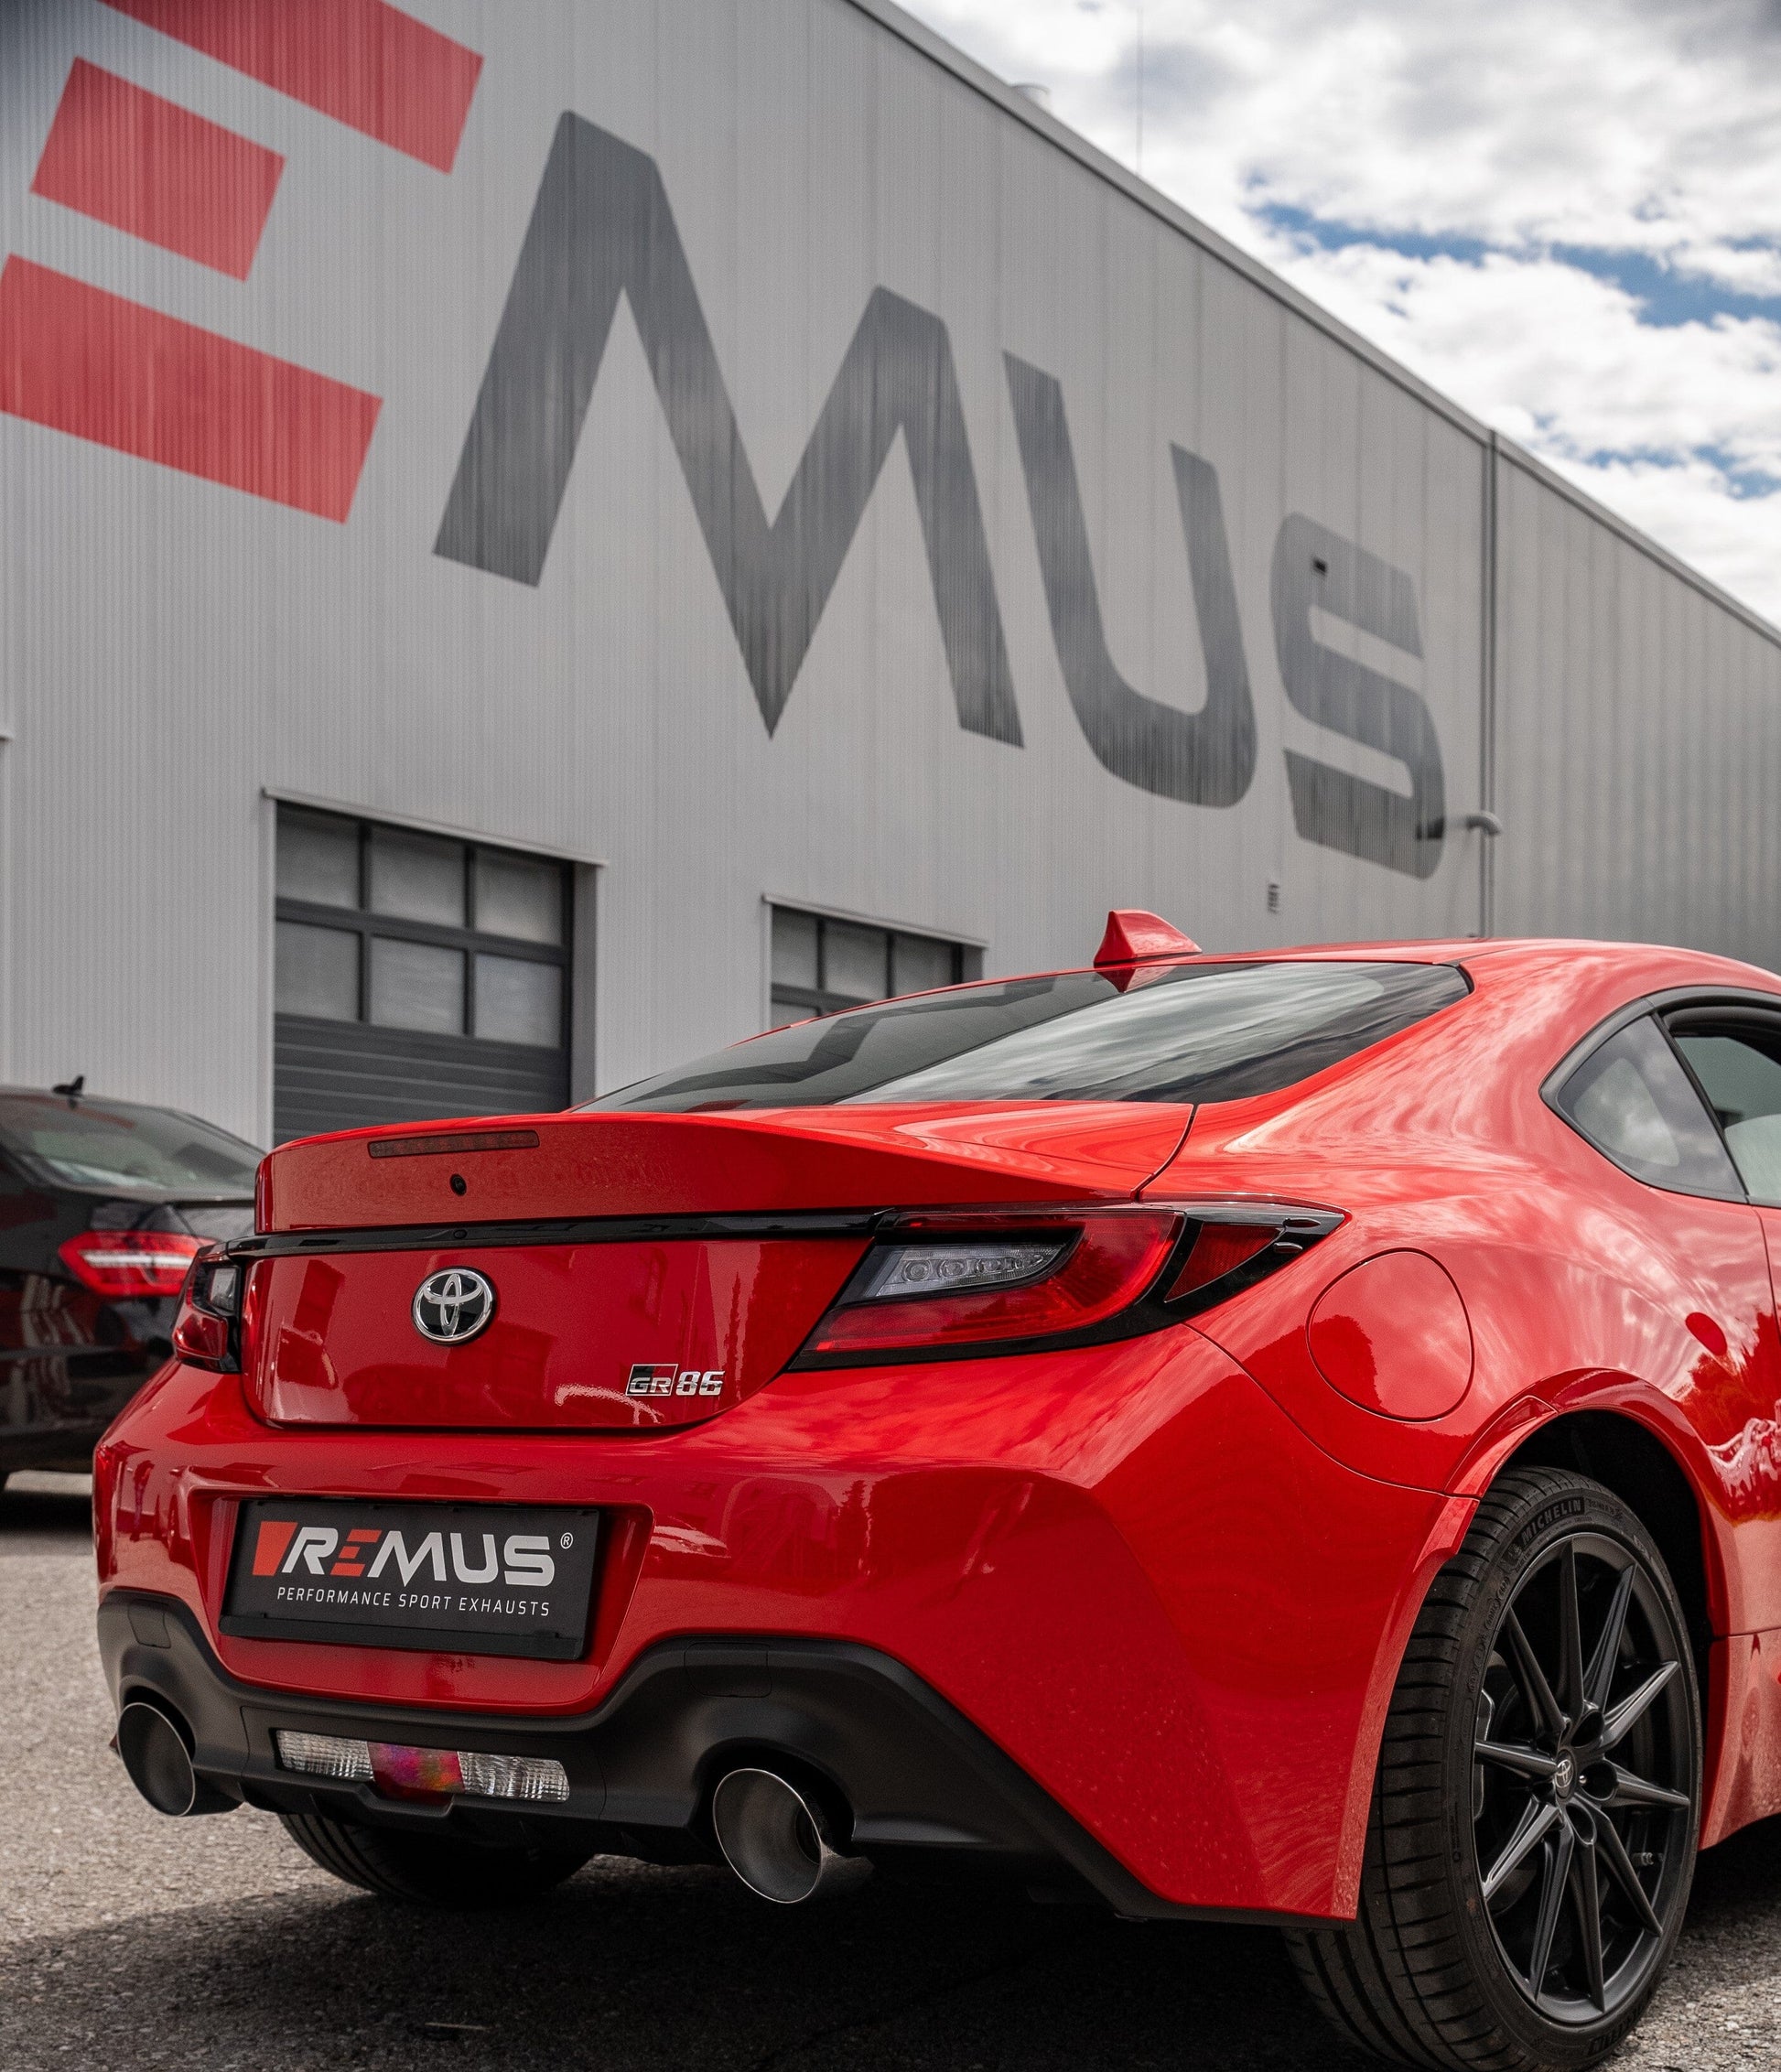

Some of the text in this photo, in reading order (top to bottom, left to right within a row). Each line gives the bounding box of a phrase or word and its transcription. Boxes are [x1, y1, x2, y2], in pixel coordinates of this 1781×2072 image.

[1521, 1499, 1581, 1546] MICHELIN
[277, 1587, 550, 1617] PERFORMANCE SPORT EXHAUSTS
